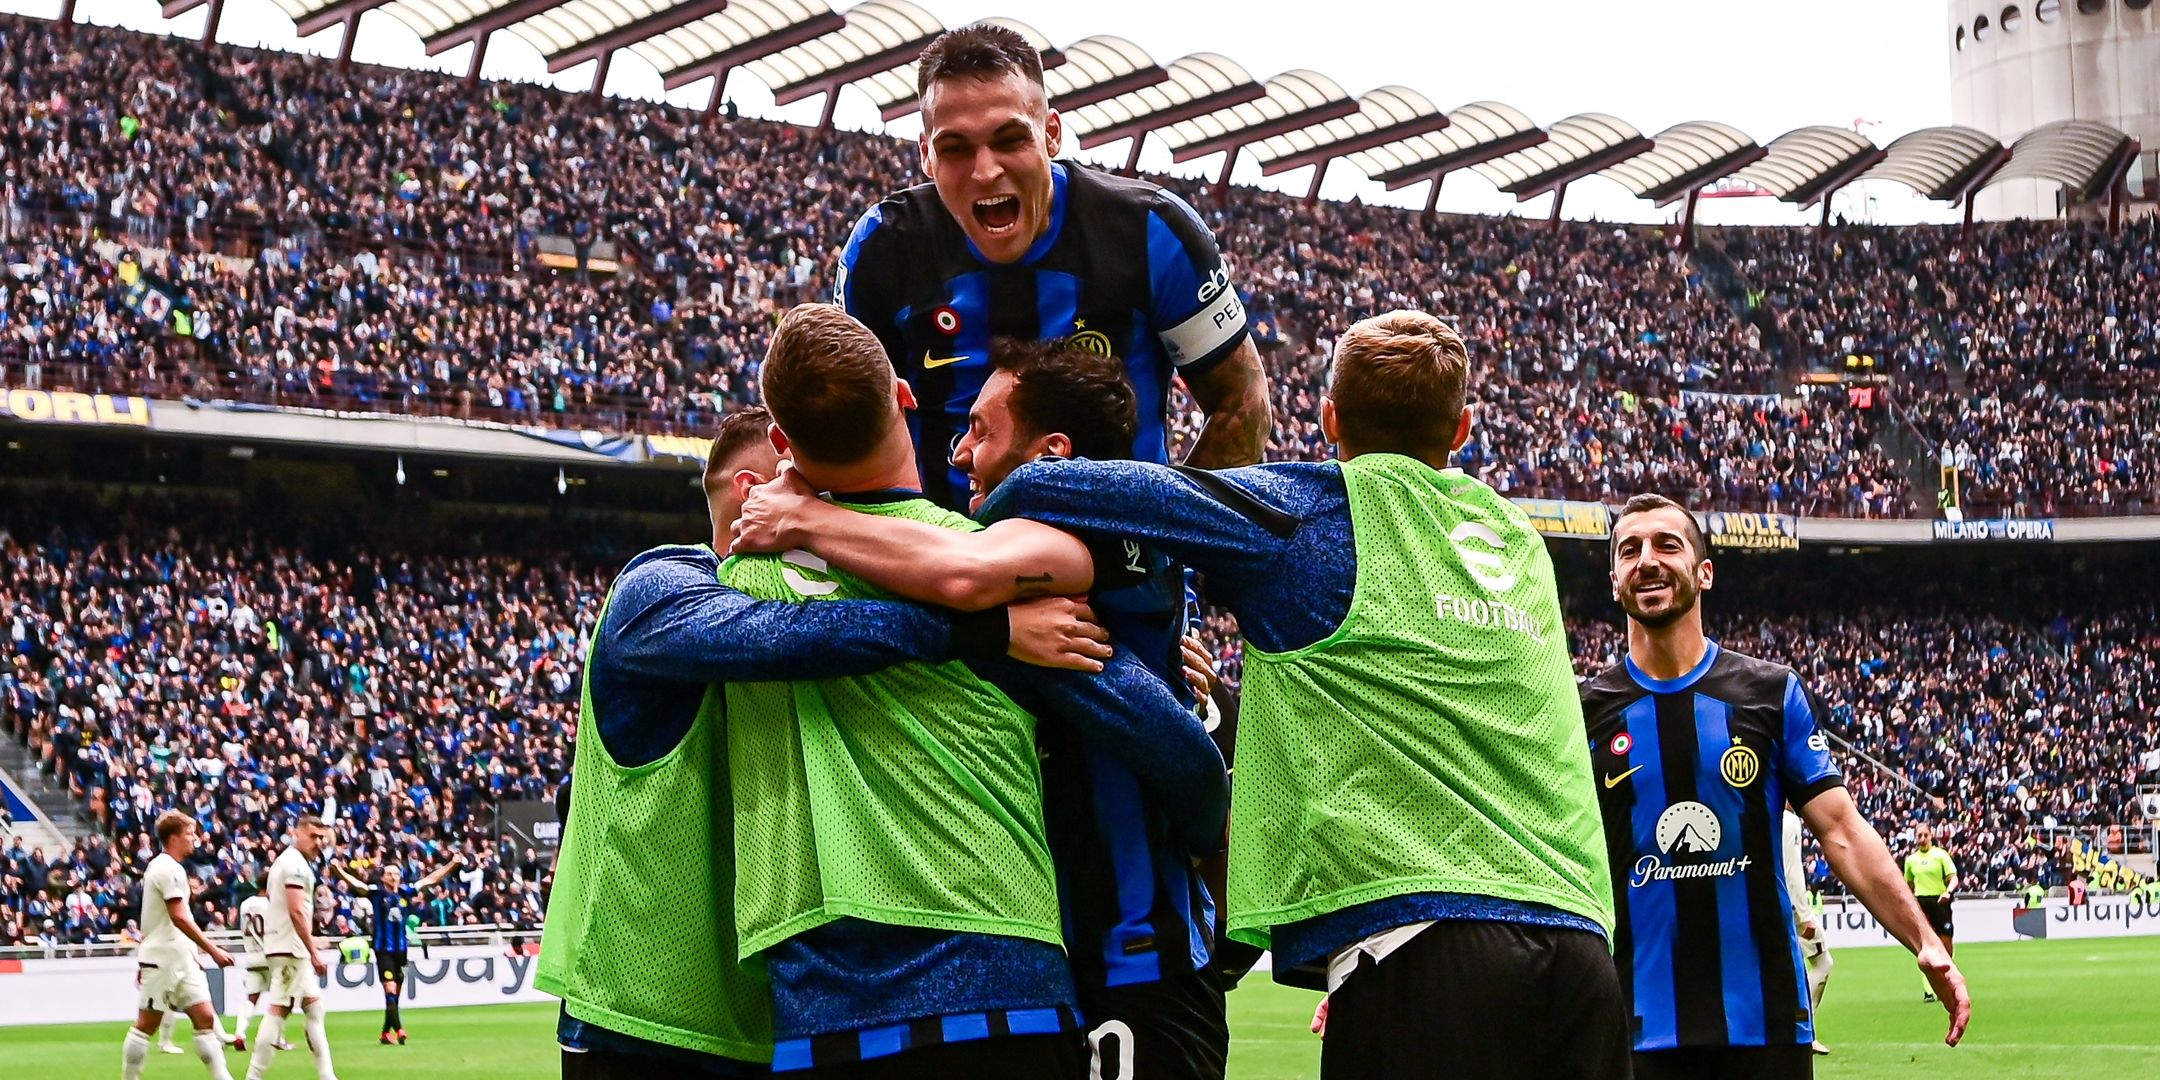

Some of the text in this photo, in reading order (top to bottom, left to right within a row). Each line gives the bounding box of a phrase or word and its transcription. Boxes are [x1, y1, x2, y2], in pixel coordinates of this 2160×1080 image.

[0, 388, 149, 425] ORLI
[1723, 512, 1781, 536] MOLE
[1934, 521, 1989, 540] MILANO
[2006, 521, 2052, 540] OPERA
[1631, 854, 1752, 888] Paramount+
